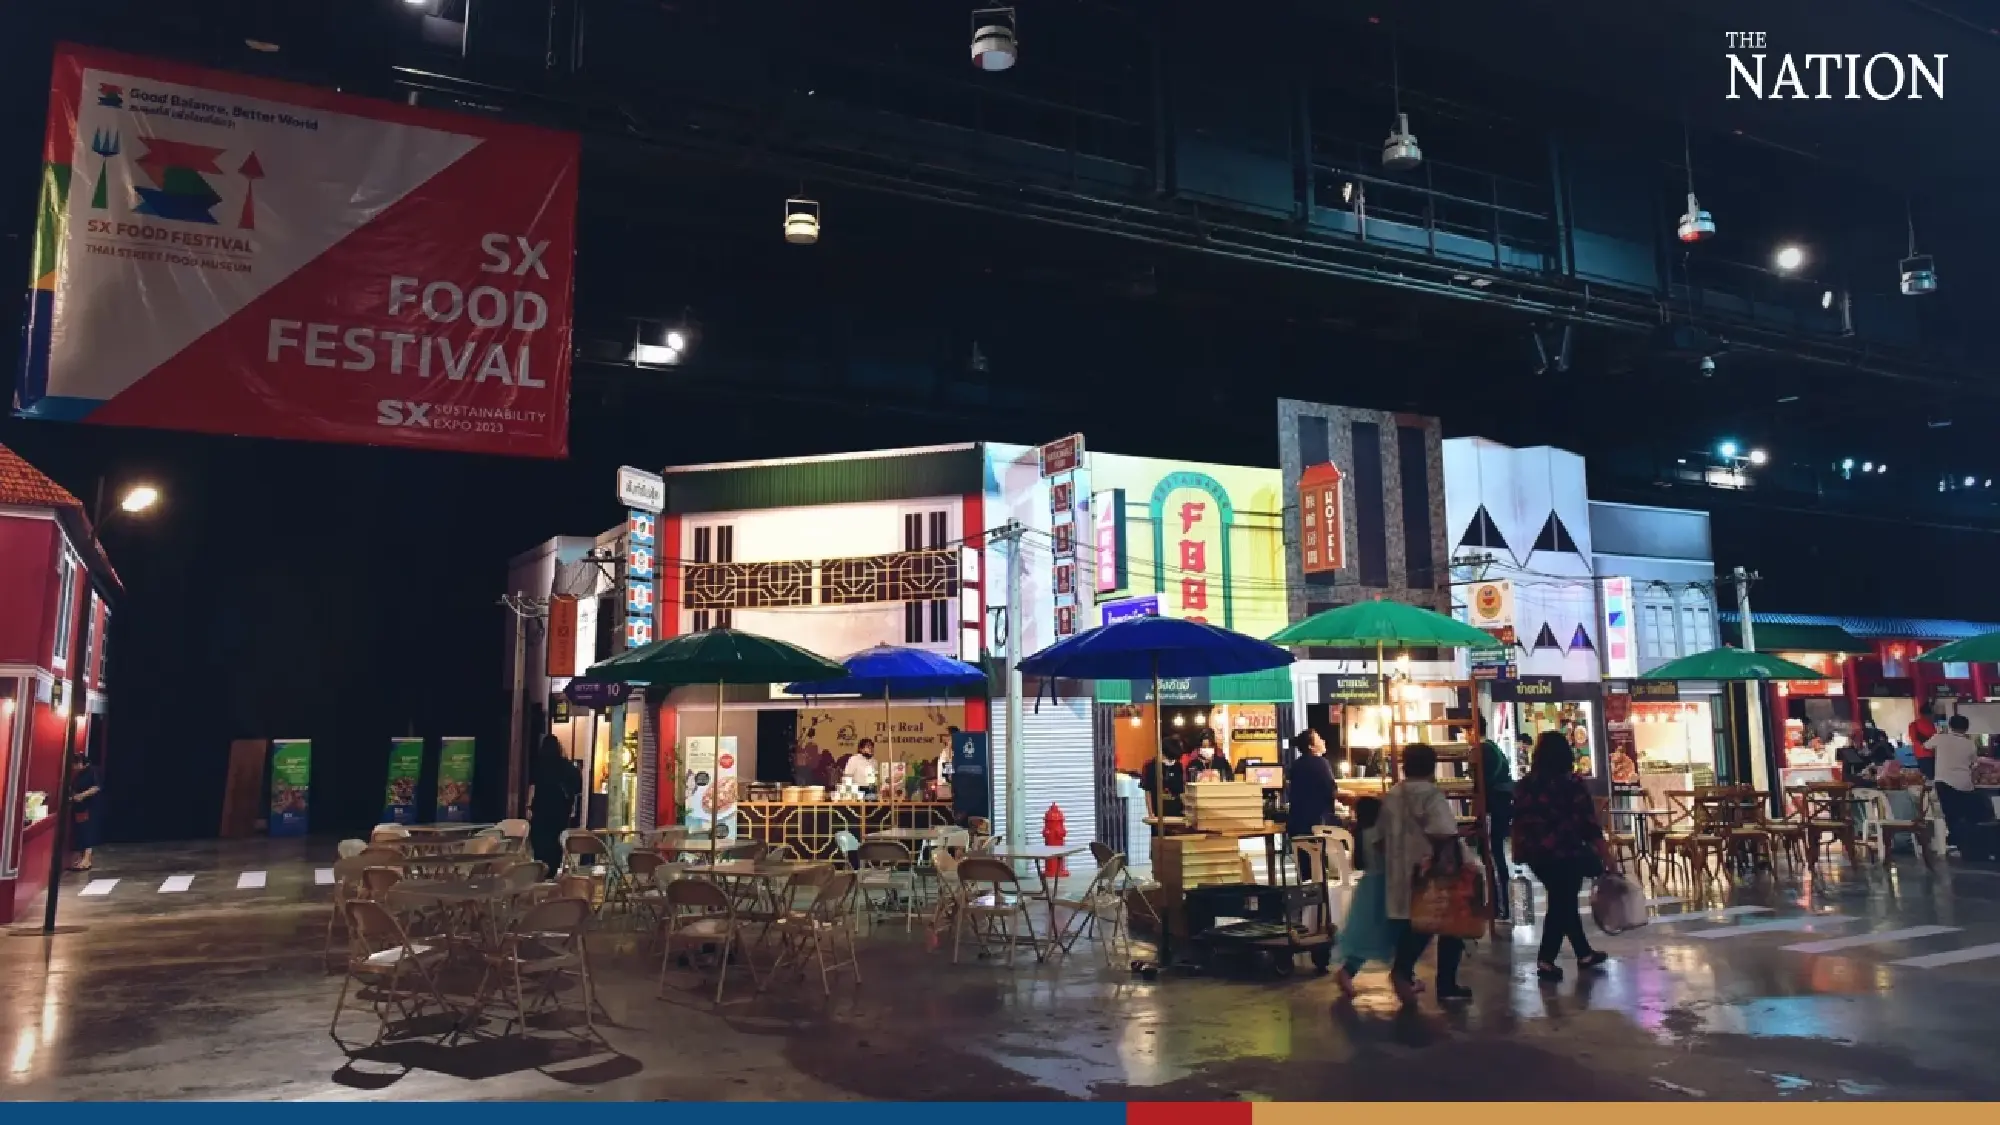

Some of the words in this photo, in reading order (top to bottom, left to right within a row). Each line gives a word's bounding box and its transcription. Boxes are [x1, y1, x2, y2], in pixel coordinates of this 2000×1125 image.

[130, 88, 168, 104] Good
[171, 94, 229, 116] Balance,
[232, 106, 276, 123] Better
[277, 113, 318, 131] World
[87, 219, 112, 235] SX
[117, 223, 167, 241] FOOD
[171, 230, 253, 253] FESTIVAL
[85, 243, 115, 257] THAI
[118, 246, 163, 262] STREET
[165, 250, 199, 266] FOOD
[201, 256, 253, 273] MUSEUM
[480, 232, 550, 280] SX
[388, 274, 549, 332] FOOD
[266, 317, 546, 389] FESTIVAL
[377, 399, 432, 427] SX
[433, 403, 547, 424] SUSTAINABILITY
[433, 418, 471, 432] EXPO
[474, 420, 505, 434] 2023
[1323, 491, 1336, 563] HOTEL
[874, 734, 935, 745] Cantonese
[899, 721, 924, 732] Real
